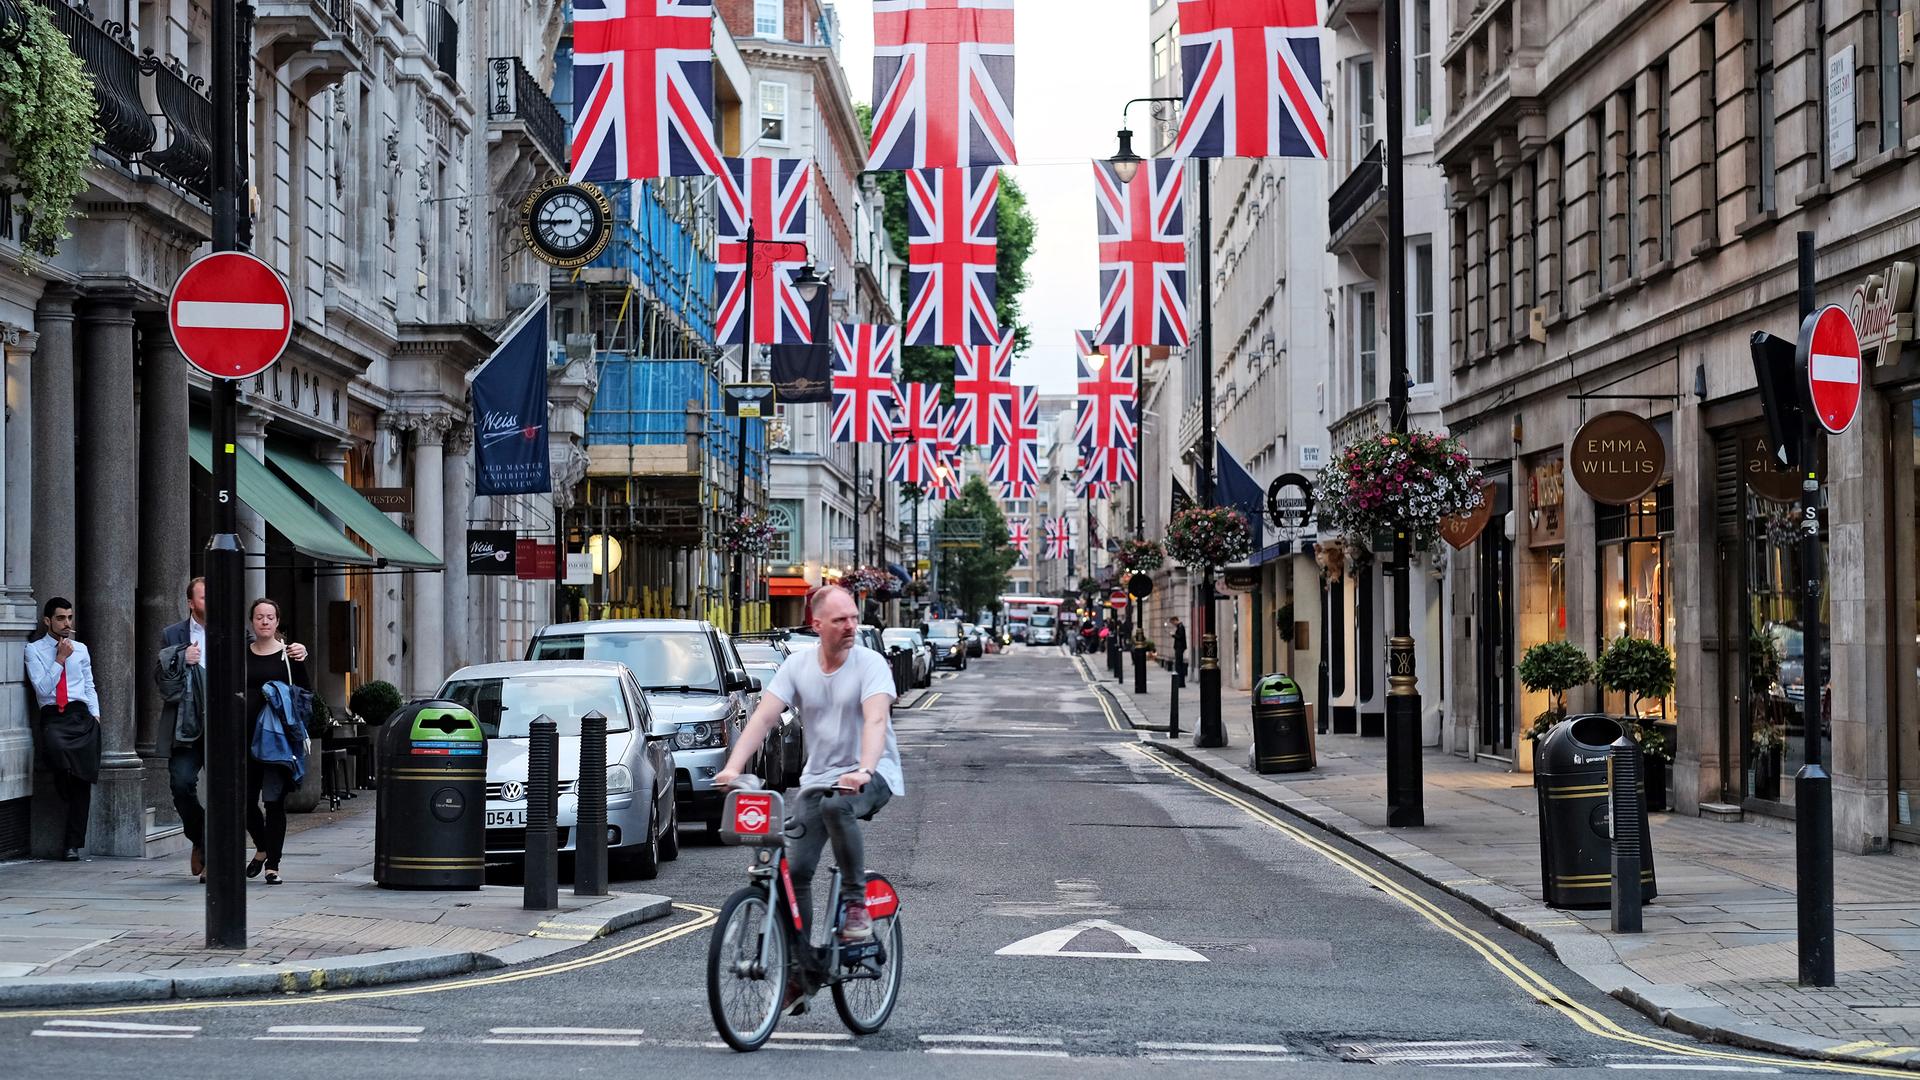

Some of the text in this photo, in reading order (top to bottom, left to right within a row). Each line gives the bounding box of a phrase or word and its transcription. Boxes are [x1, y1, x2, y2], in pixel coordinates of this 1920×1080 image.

[1830, 78, 1842, 99] STREET
[523, 187, 543, 214] SIMON
[597, 195, 610, 214] LTD
[522, 226, 531, 241] OLD
[532, 245, 558, 264] MODERN
[559, 257, 587, 266] MASTER
[586, 229, 610, 259] PAINTINGS
[480, 411, 518, 431] Weiss
[1588, 439, 1647, 453] EMMA
[506, 462, 543, 471] MASTER
[1582, 460, 1654, 473] WILLIS
[484, 471, 542, 481] EXHIBITION
[494, 480, 532, 489] ON VIEW
[219, 490, 229, 503] 5
[1450, 521, 1468, 534] 67
[469, 540, 494, 553] Weiss
[1586, 755, 1605, 763] general
